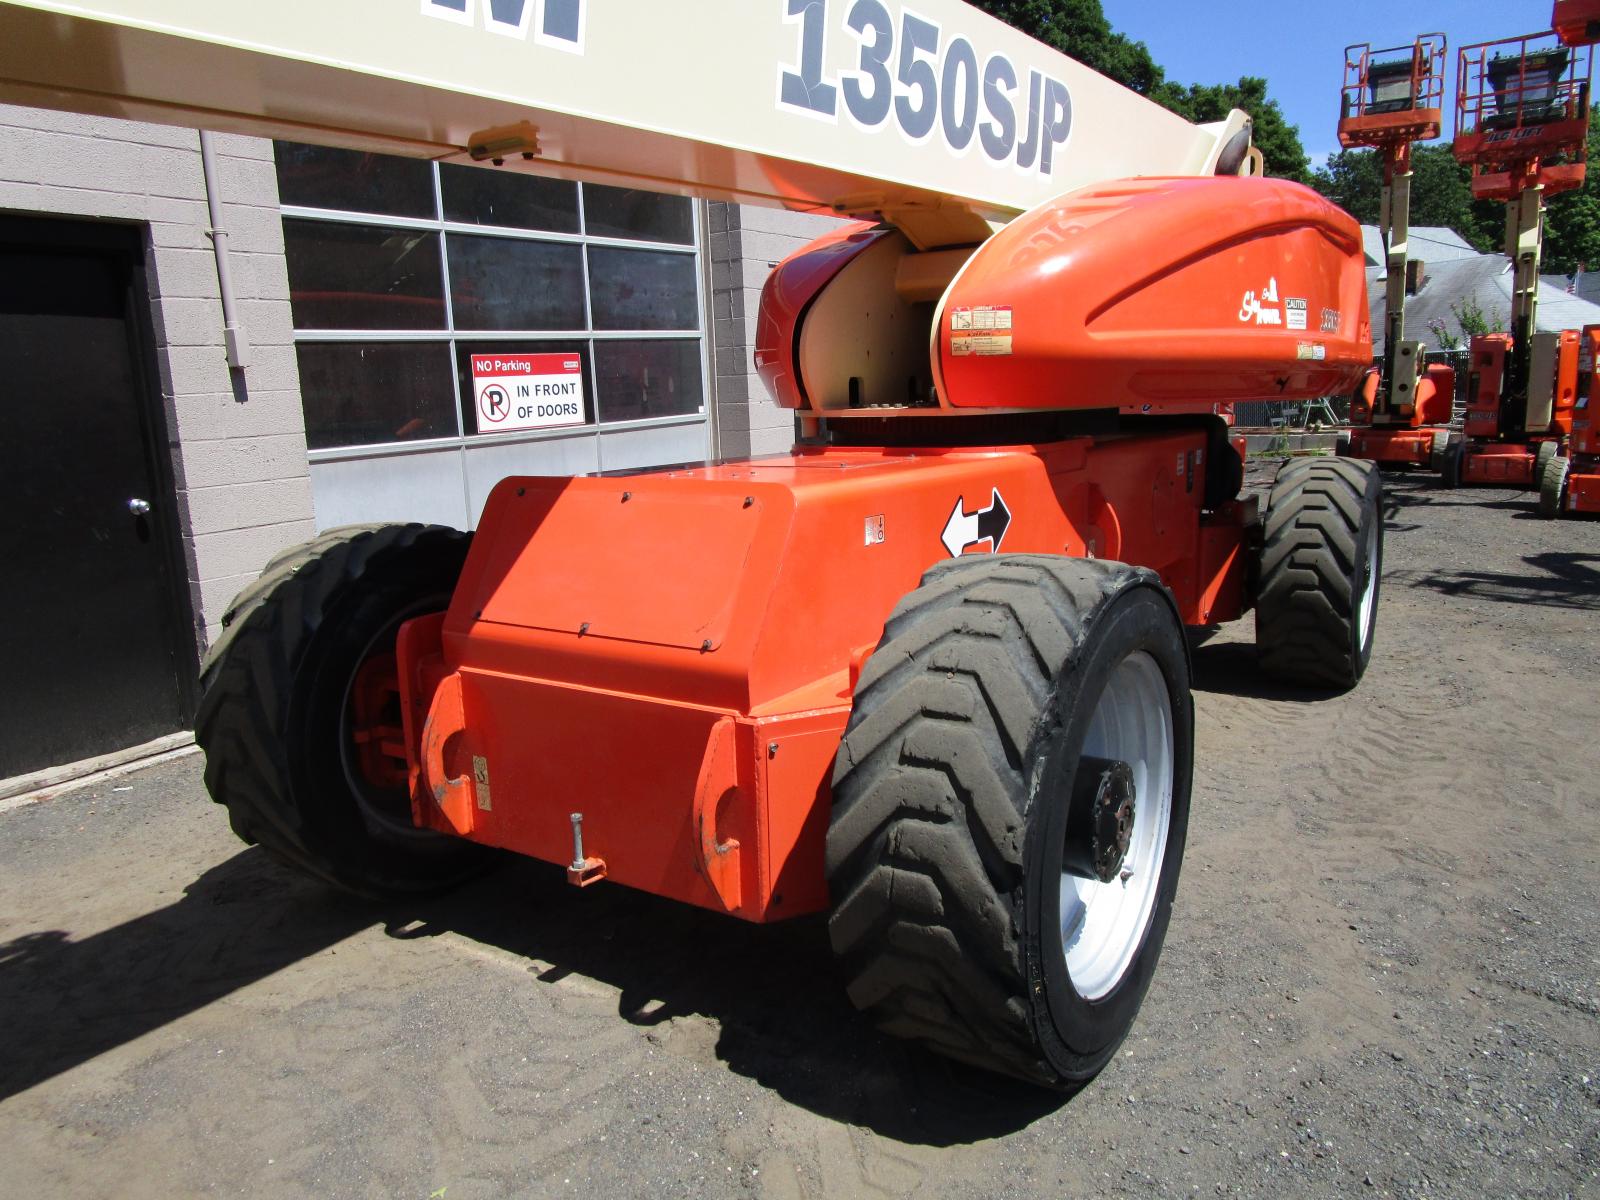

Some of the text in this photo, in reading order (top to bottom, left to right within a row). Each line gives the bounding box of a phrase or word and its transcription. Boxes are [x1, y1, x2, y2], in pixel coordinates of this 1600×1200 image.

[775, 0, 1073, 183] 1350SJP
[476, 360, 531, 372] NO Parking
[517, 382, 576, 397] IN FRONT
[517, 403, 578, 418] OF DOORS
